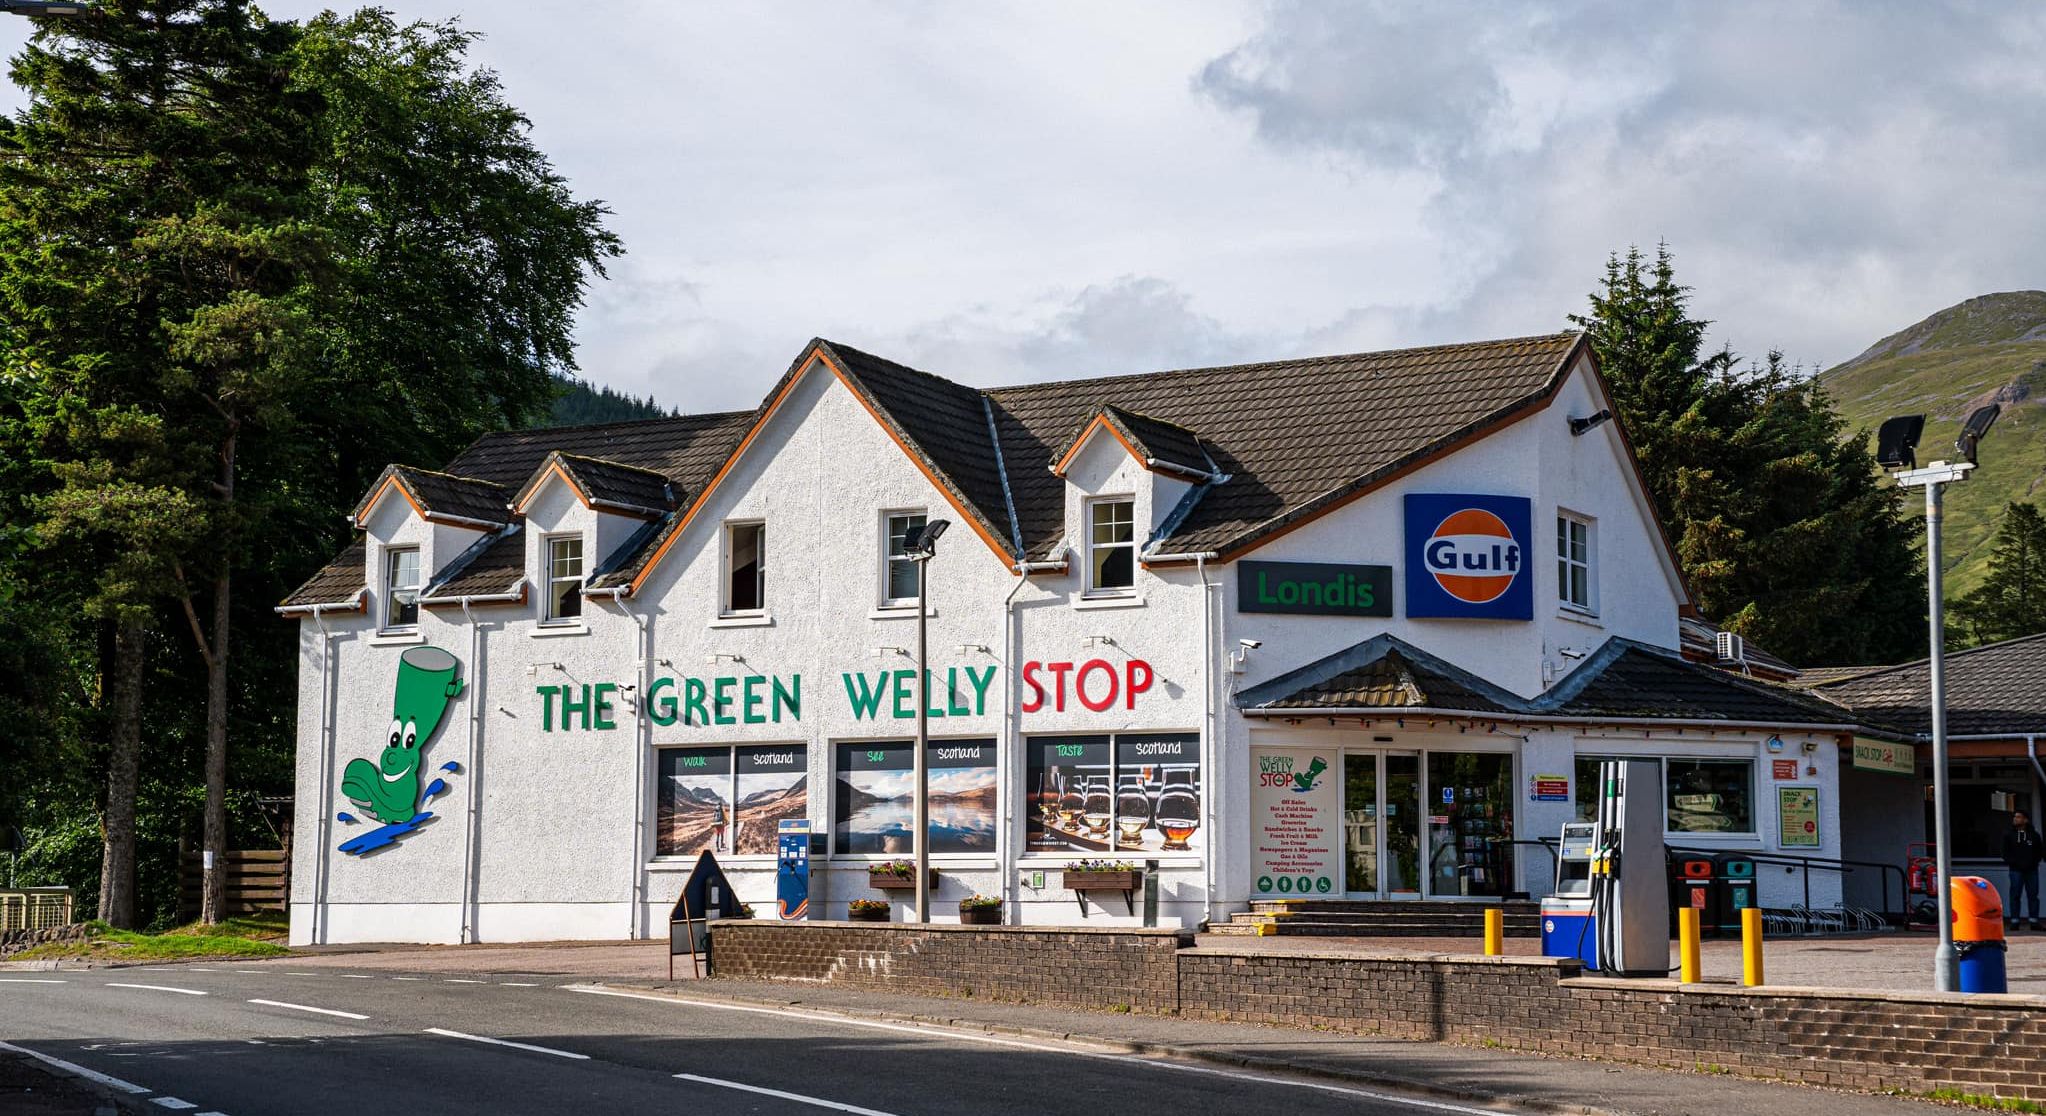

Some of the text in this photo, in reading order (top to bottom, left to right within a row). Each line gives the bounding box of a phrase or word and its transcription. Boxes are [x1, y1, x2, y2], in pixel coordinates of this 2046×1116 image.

[1426, 541, 1519, 571] Gulf
[1258, 572, 1375, 607] Londis
[537, 659, 1154, 732] THE GREEN WELLY STOP
[867, 746, 980, 762] See Scotland
[1056, 741, 1182, 757] Taste Scotland
[683, 751, 793, 767] Walk Scotland
[1260, 762, 1293, 773] WELLY
[1260, 773, 1293, 787] STOP
